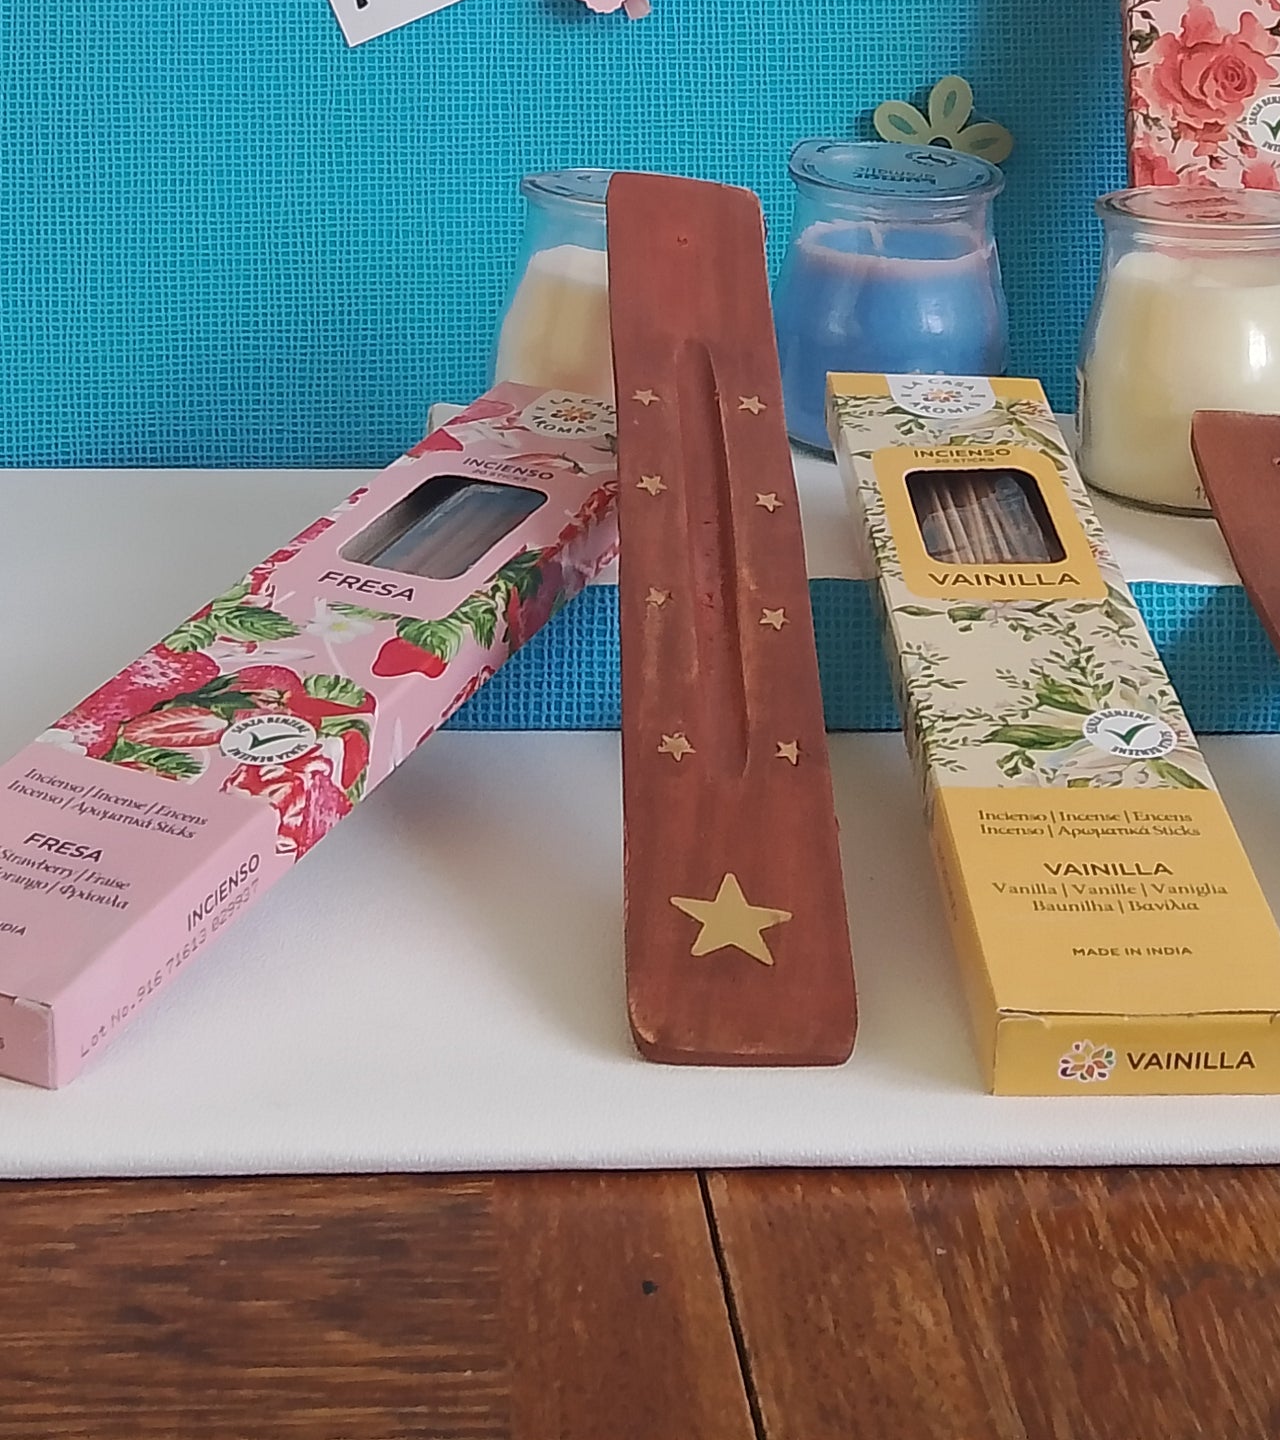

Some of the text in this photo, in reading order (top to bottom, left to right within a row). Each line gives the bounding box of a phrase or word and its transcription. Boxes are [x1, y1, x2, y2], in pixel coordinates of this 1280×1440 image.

[927, 378, 975, 392] CASA
[908, 401, 982, 414] AROMAS
[532, 413, 597, 434] AROMAS
[913, 447, 1012, 459] INCIENSO
[463, 457, 555, 481] INCIENSO
[317, 571, 415, 602] FRESA
[927, 572, 1081, 586] VAINILLA
[24, 768, 208, 826] Incienso Incense Encens
[7, 779, 64, 805] Incenso
[152, 820, 196, 839] Sticks
[978, 809, 1193, 822] Incienso Incense Encens
[980, 823, 1045, 836] Incenso
[1153, 824, 1201, 837] Sticks
[23, 832, 103, 863] FRESA
[1043, 861, 1175, 877] VAINILLA
[84, 871, 131, 891] Fraise
[992, 881, 1229, 898] Vanilla Vanille Vaniglia
[186, 853, 260, 932] INCIENSO
[1032, 899, 1114, 913] Baunilha
[1072, 945, 1193, 957] MADE IN INDIA
[81, 1024, 107, 1059] Lot
[1126, 1051, 1256, 1071] VAINILLA
